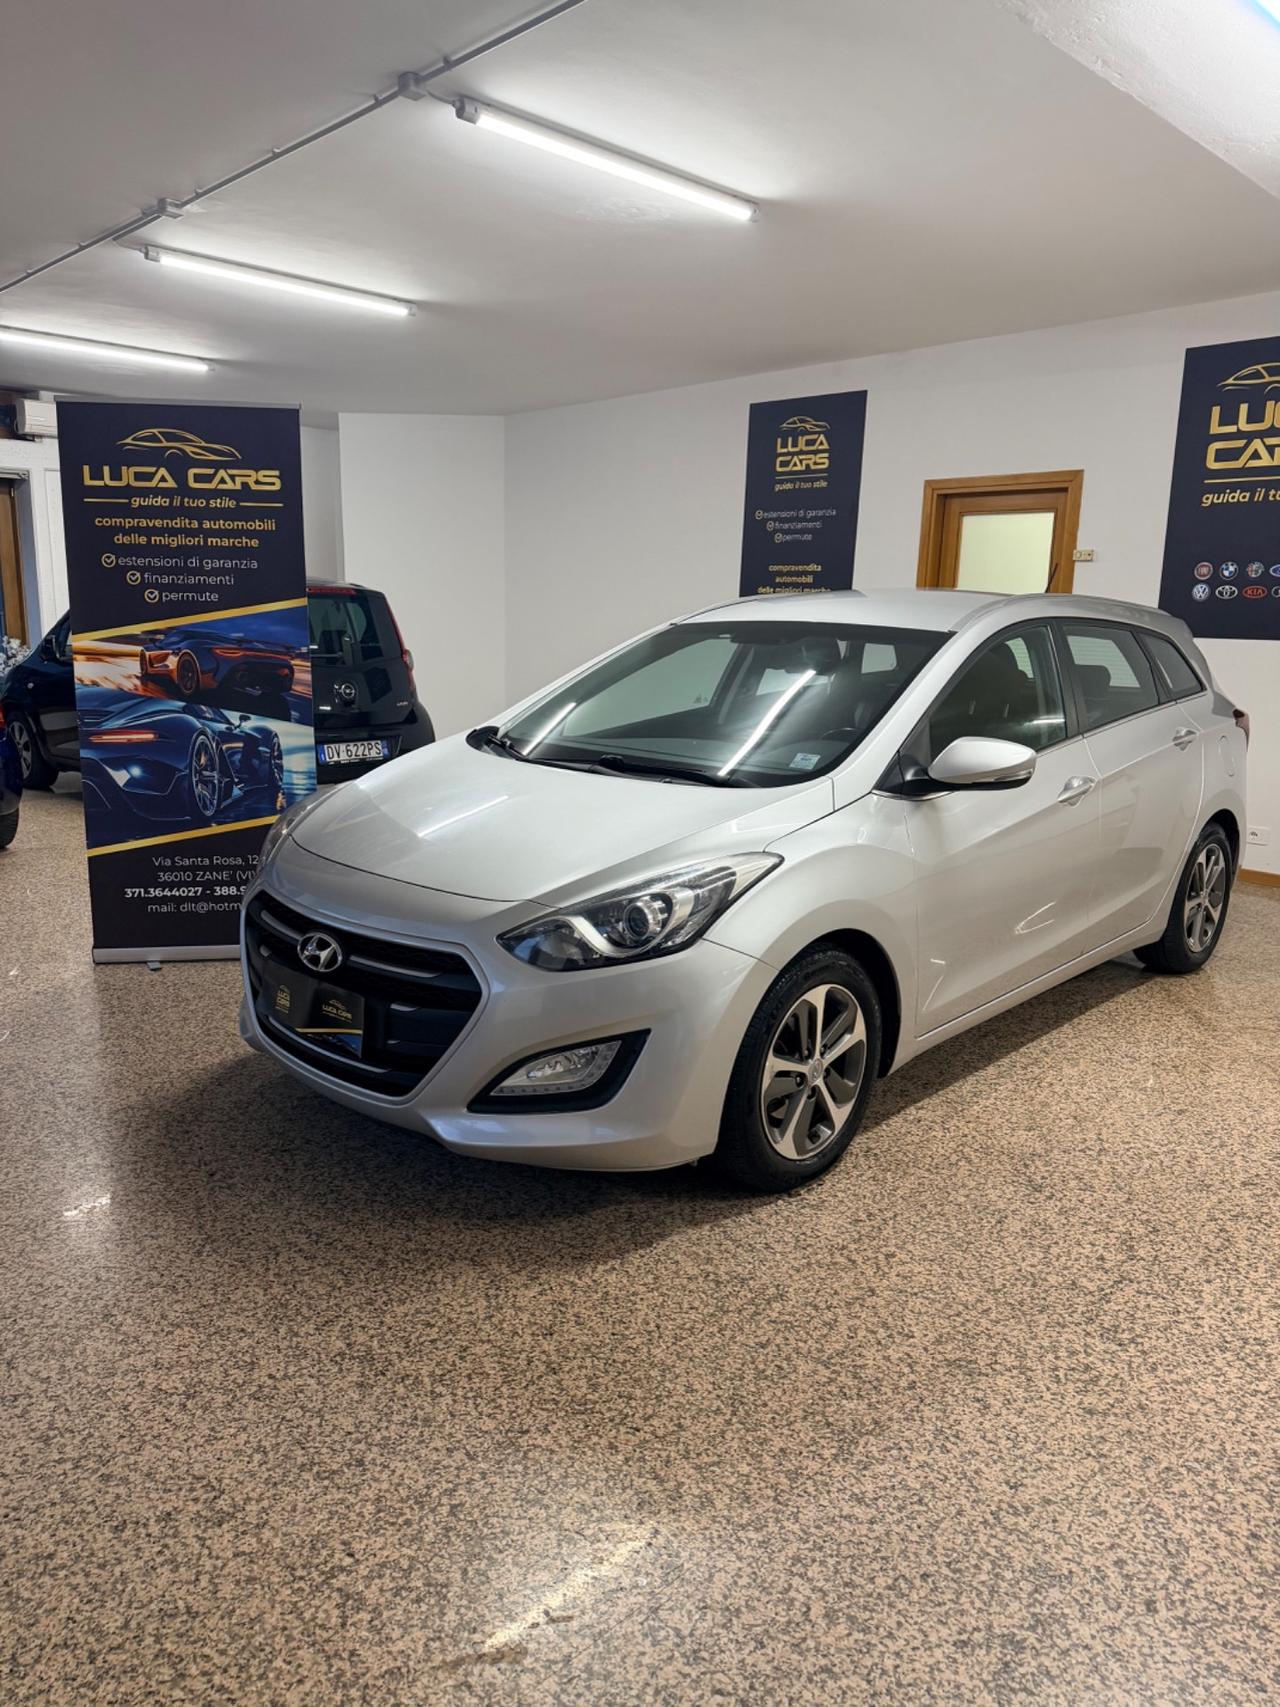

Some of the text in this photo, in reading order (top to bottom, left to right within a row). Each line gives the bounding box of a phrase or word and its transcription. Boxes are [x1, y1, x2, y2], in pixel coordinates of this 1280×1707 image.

[1209, 400, 1280, 434] LU
[776, 433, 830, 453] LUCA
[1206, 437, 1280, 470] CA
[776, 453, 830, 472] CARS
[82, 464, 282, 491] LUCA CARS
[774, 481, 794, 492] guida
[813, 480, 828, 489] stile
[130, 494, 237, 509] guida il tuo stile
[1201, 489, 1250, 507] guida
[1254, 488, 1266, 502] il
[806, 508, 836, 519] garanzia
[95, 516, 276, 531] compravendita automobili
[774, 520, 822, 530] finanziamenti
[114, 533, 260, 548] delle migliori marche
[118, 555, 259, 570] estensioni di garanzia
[768, 563, 822, 573] compravendita
[143, 572, 235, 586] finanziamenti
[775, 575, 814, 583] automobili
[162, 590, 219, 603] permute
[326, 742, 382, 760] DV 622PS
[152, 856, 172, 867] Via
[174, 856, 210, 867] Santa
[213, 855, 245, 868] Rosa,
[157, 871, 194, 882] 36010
[196, 871, 233, 882] ZANE'
[124, 887, 203, 898] 371.3644027
[147, 902, 242, 913] mail: dlt@hotm
